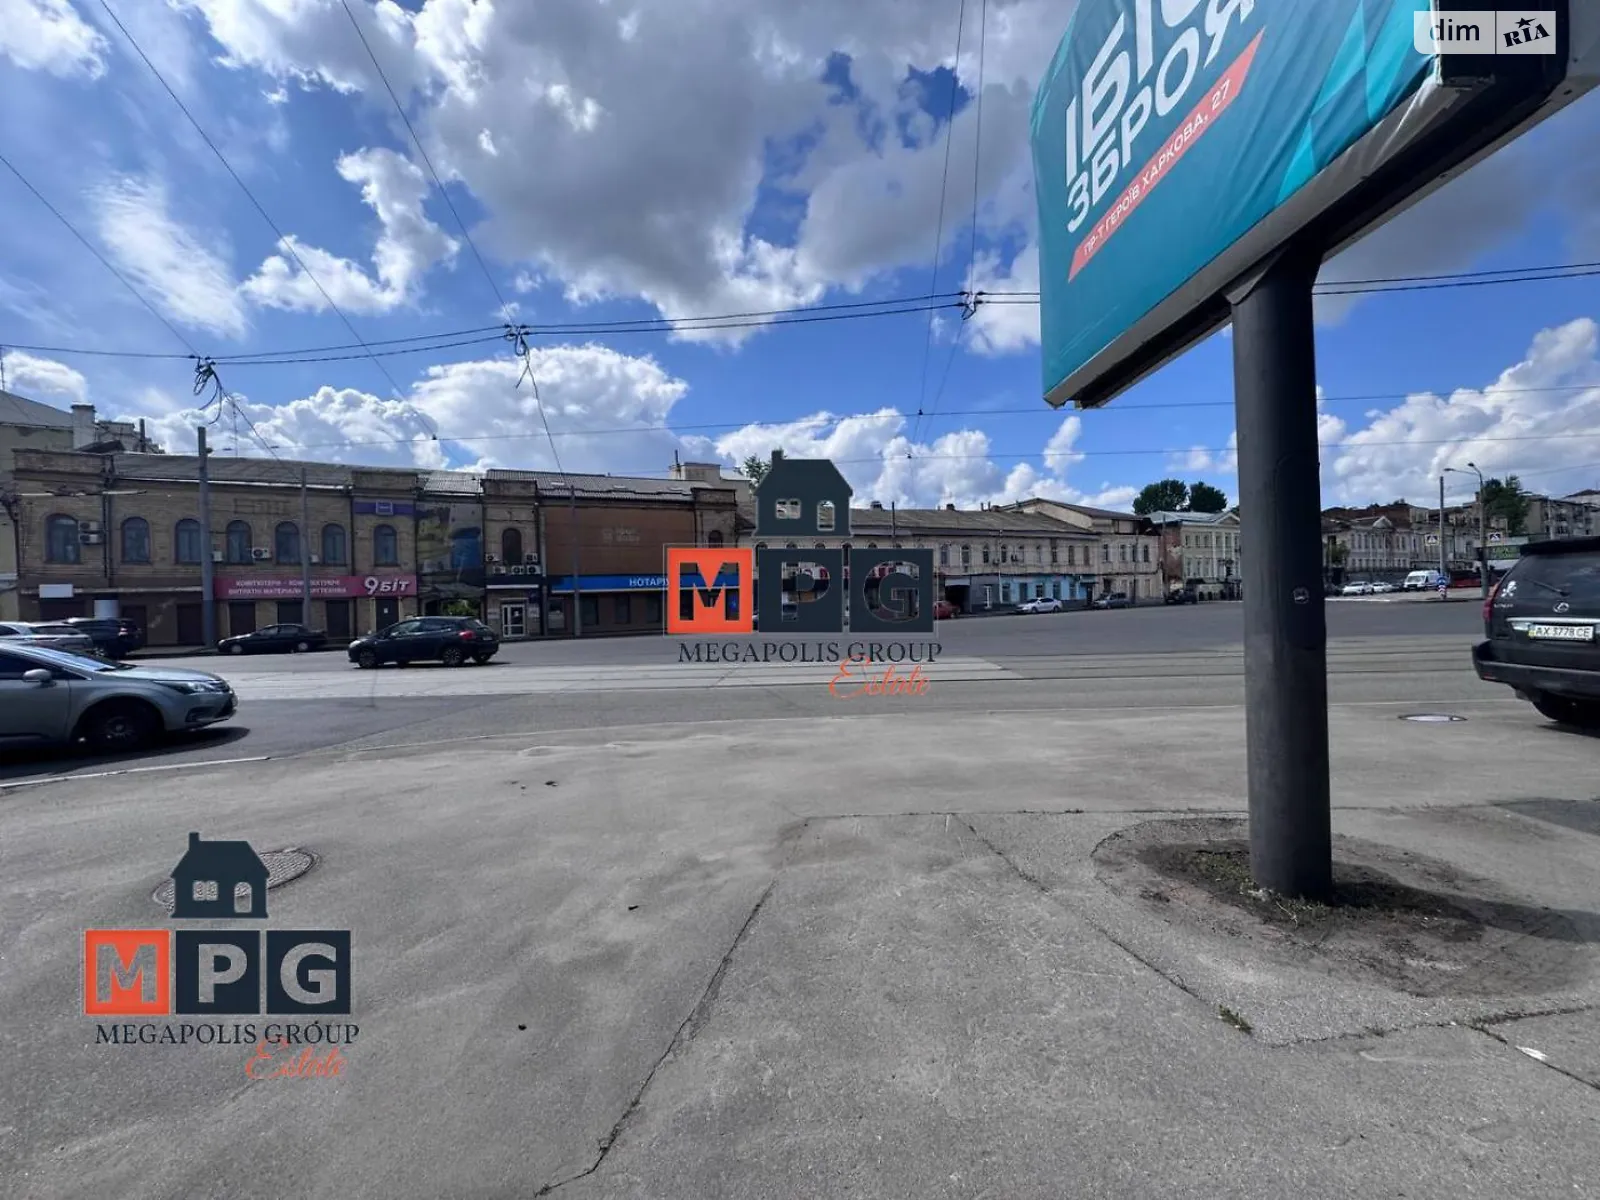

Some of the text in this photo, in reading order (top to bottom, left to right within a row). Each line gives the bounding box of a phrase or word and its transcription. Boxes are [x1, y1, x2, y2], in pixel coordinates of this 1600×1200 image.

[1105, 183, 1141, 232] ГЕРОЇВ
[1142, 112, 1209, 190] ХАРКОВА,
[1211, 78, 1231, 112] 27
[1536, 626, 1550, 636] AX
[1576, 628, 1590, 638] CE
